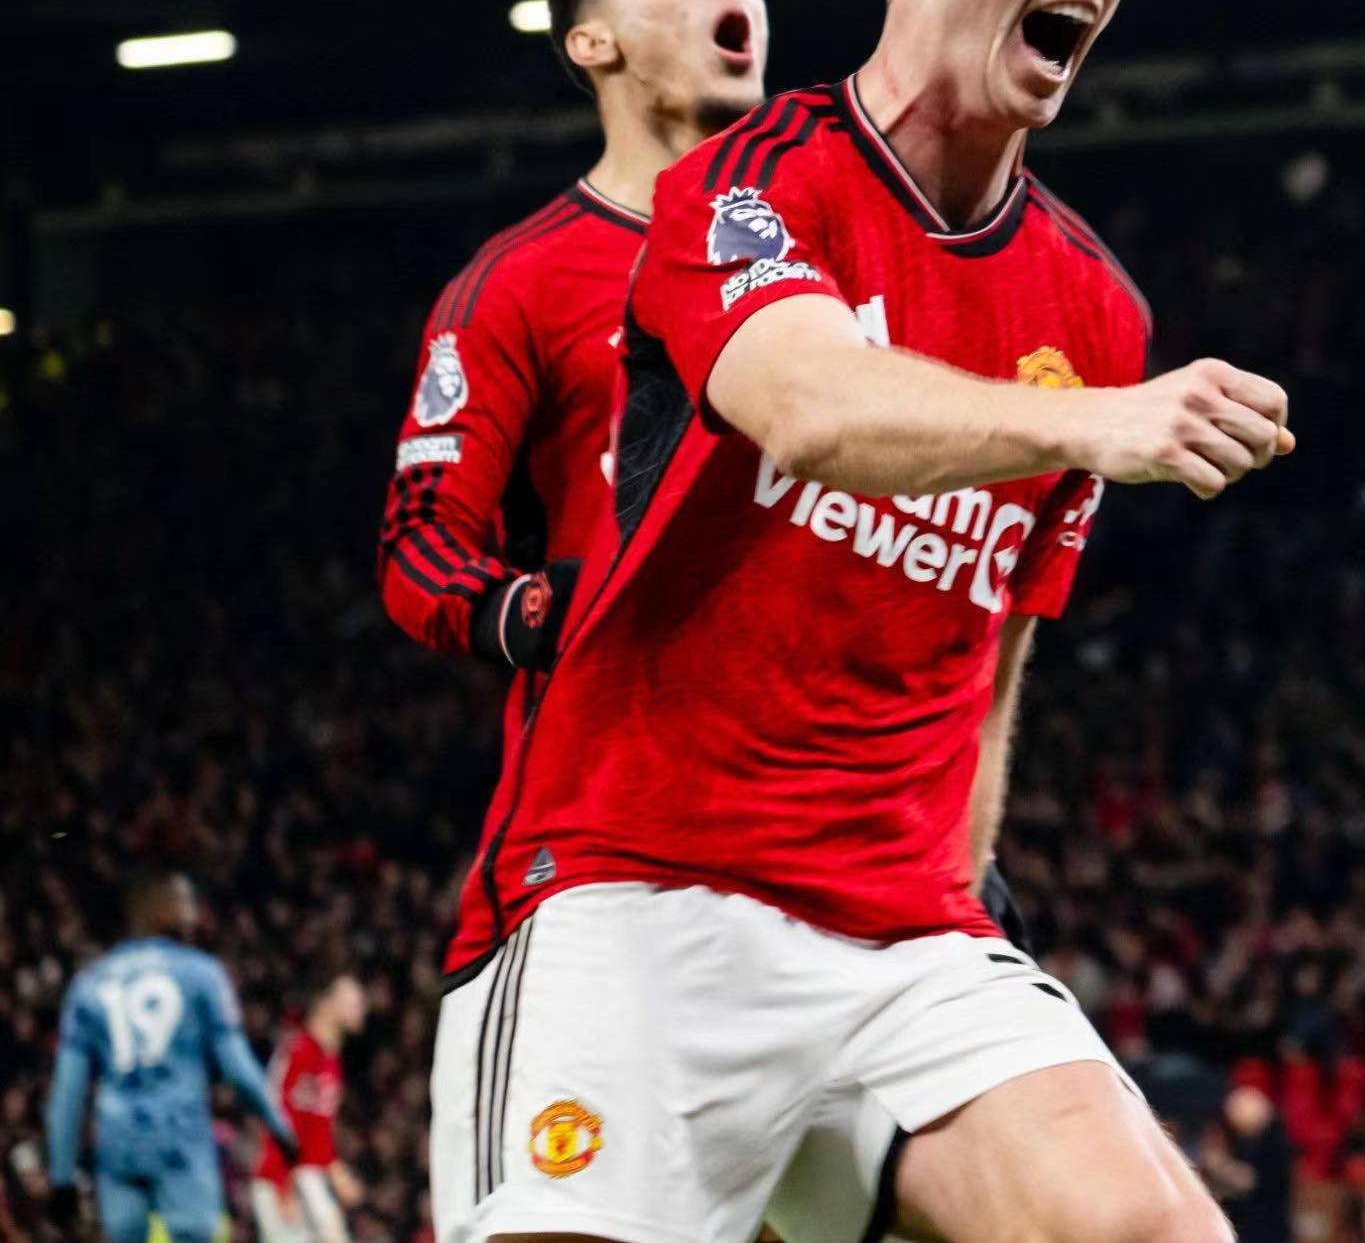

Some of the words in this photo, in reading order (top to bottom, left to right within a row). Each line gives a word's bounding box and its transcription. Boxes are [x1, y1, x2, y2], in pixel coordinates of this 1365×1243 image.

[753, 451, 978, 592] Viewer
[891, 486, 993, 541] am
[97, 970, 184, 1074] 19
